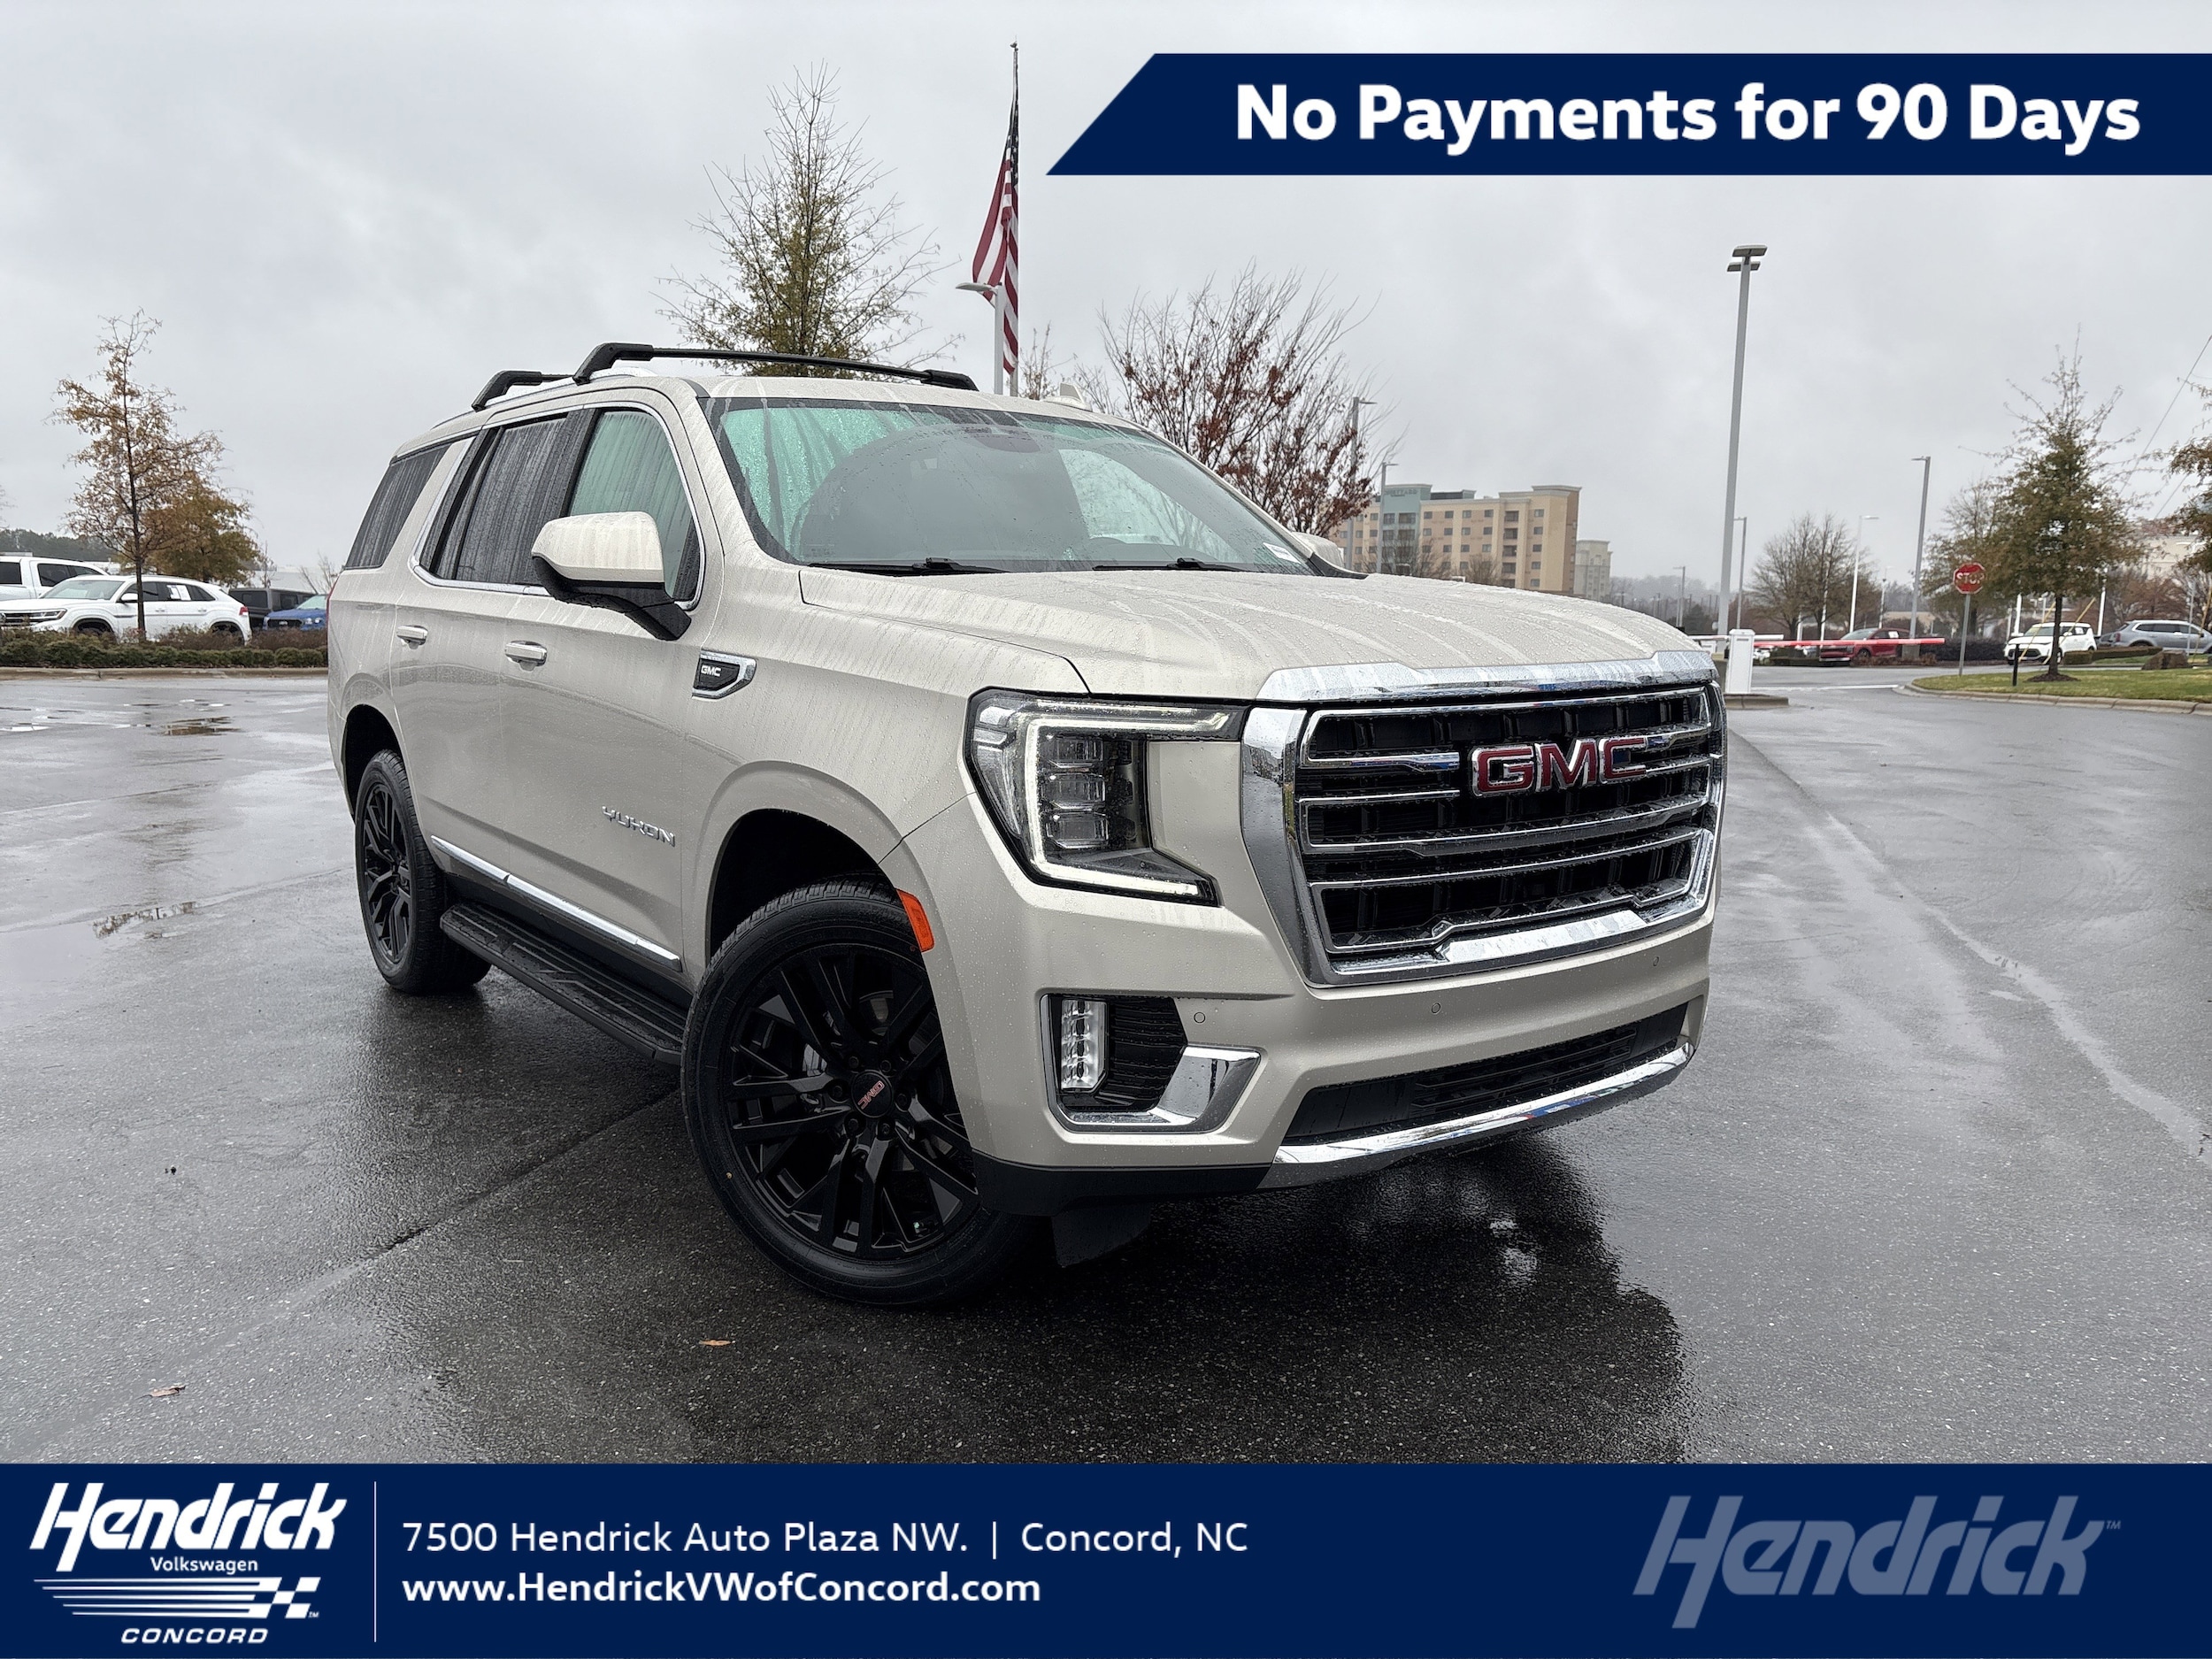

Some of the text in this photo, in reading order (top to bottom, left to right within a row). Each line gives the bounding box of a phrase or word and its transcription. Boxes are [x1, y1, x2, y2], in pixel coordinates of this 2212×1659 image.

[701, 664, 722, 677] GMC
[1471, 739, 1647, 796] GMC
[602, 806, 675, 847] YUKON
[857, 1080, 886, 1110] GMC
